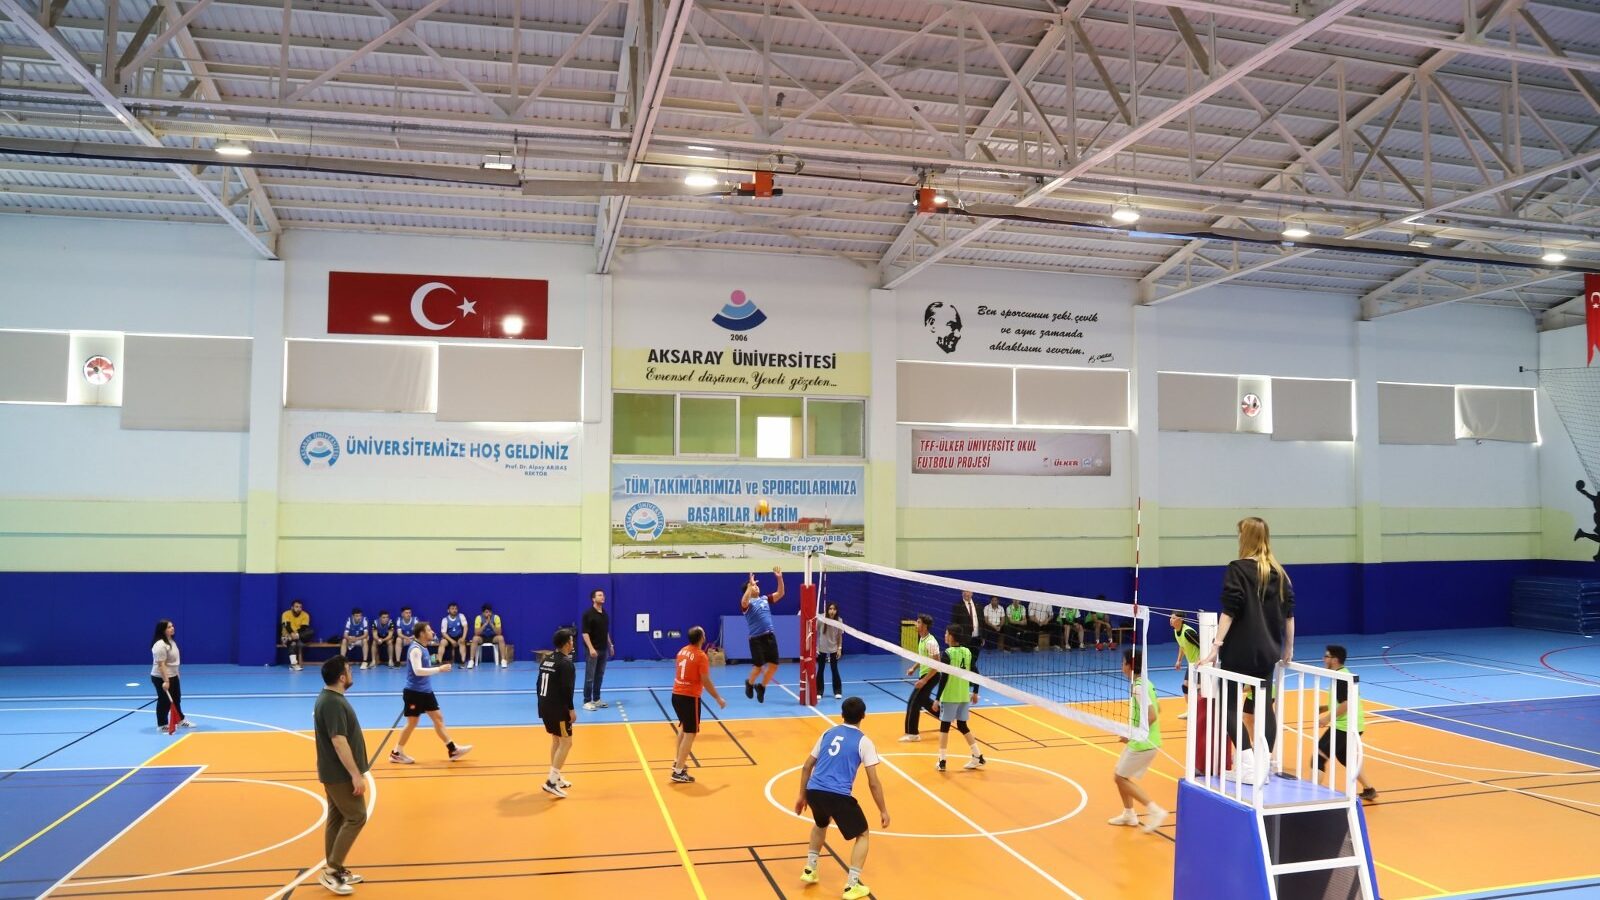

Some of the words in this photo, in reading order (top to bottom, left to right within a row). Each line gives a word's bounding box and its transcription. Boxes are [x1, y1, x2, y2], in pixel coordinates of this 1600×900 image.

[977, 305, 997, 316] Ben
[1000, 309, 1050, 319] sporcunun
[1074, 312, 1098, 324] çevik
[730, 333, 748, 342] 2006
[1039, 329, 1083, 339] zamanda
[989, 341, 1042, 352] ahlaklısını
[1045, 347, 1085, 355] severim.
[647, 349, 724, 365] AKSARAY
[732, 349, 837, 370] ÜNİVERSİTESİ
[645, 366, 695, 382] Evrensel
[751, 371, 786, 391] Yereli
[346, 436, 466, 458] ÜNİVERSİTEMİZE
[470, 442, 501, 463] HOŞ
[505, 441, 569, 461] GELDİNİZ
[920, 437, 965, 452] TFF-ÜLKER
[1017, 440, 1037, 452] OKUL
[916, 456, 955, 469] FUTBOLU
[957, 453, 991, 468] PROJESİ
[625, 475, 650, 494] TÜM
[653, 478, 742, 495] TAKIMLARIMIZA
[745, 481, 759, 495] ve
[762, 479, 857, 496] SPORCULARIMIZA
[687, 506, 750, 524] BAŞARILAR
[762, 535, 783, 543] Prof.
[797, 535, 821, 544] Alpay
[678, 658, 688, 680] 1
[539, 672, 550, 697] 11
[828, 735, 844, 757] 5
